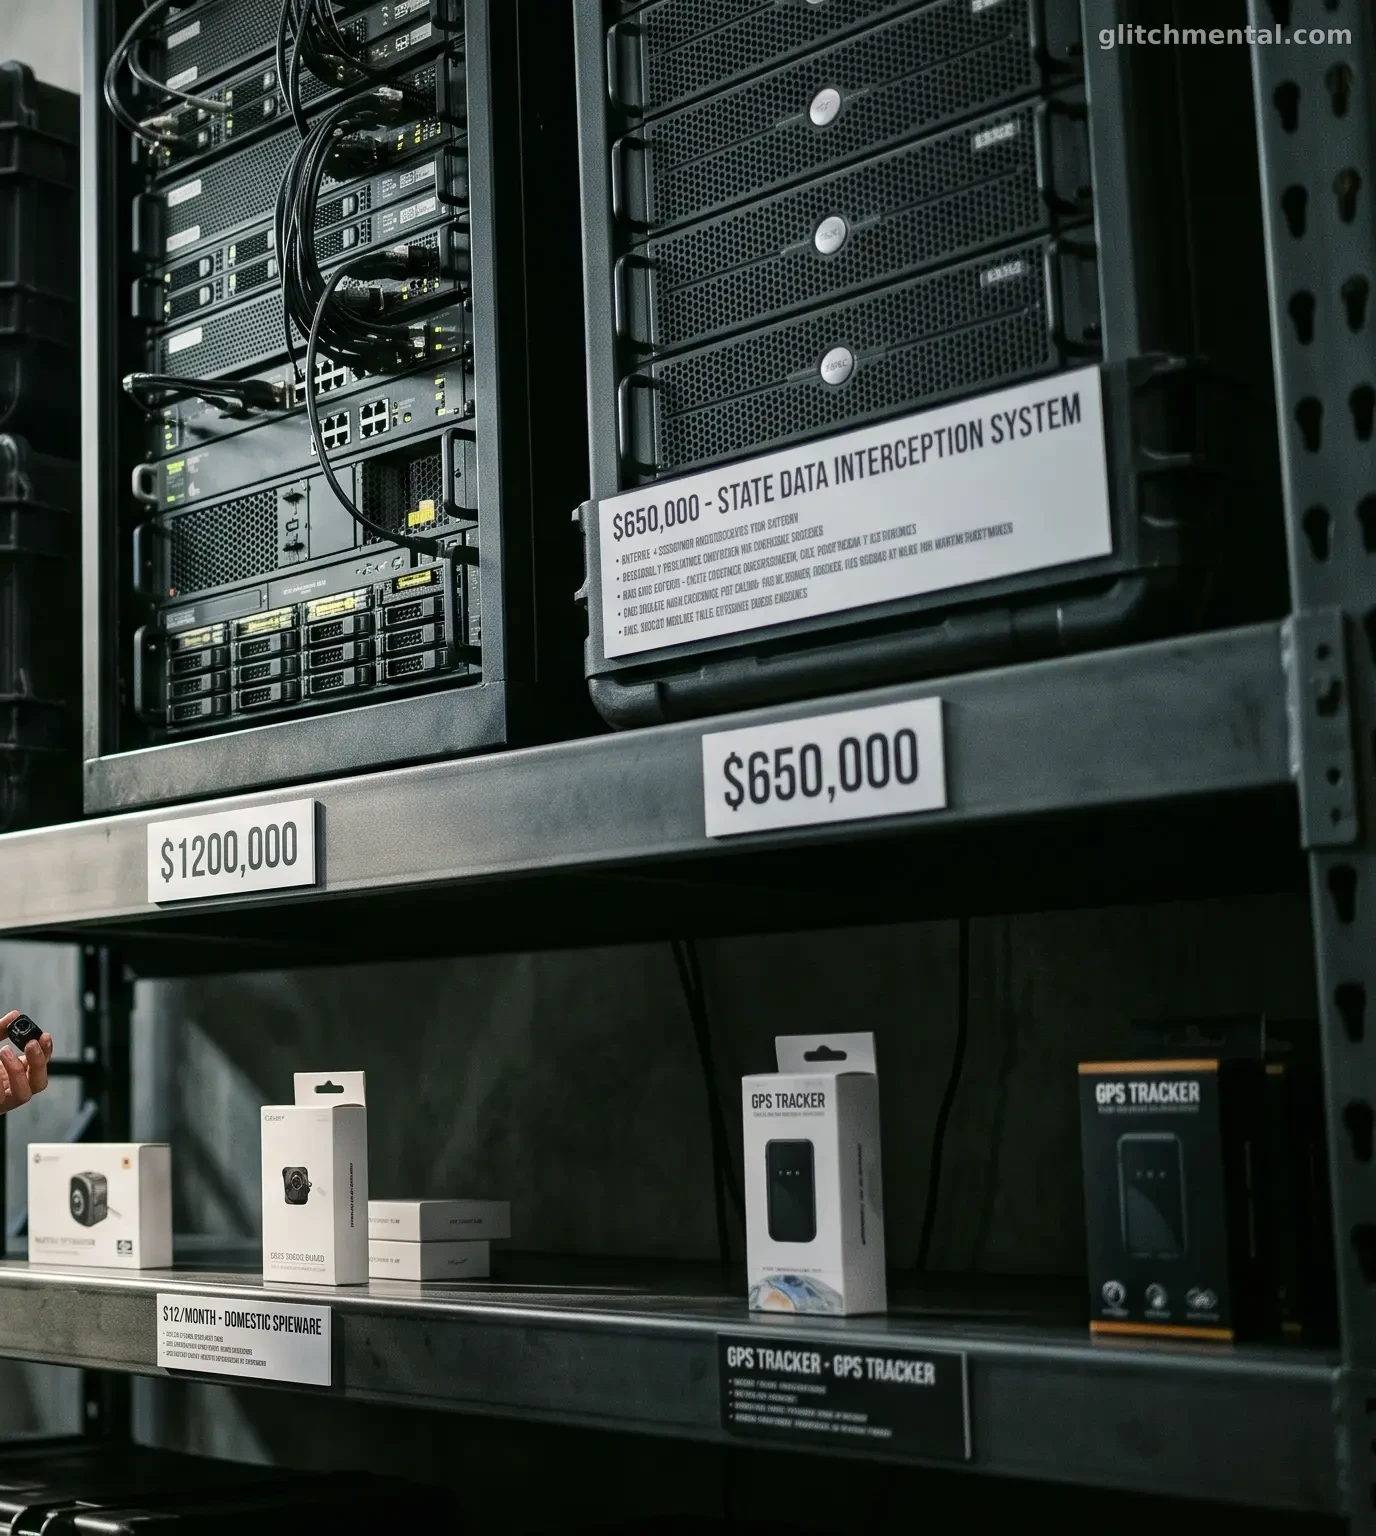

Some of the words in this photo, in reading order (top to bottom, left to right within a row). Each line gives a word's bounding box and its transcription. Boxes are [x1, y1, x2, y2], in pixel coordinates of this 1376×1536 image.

[613, 494, 700, 542] $650,000
[718, 474, 774, 514] STATE
[780, 461, 828, 499] DATA
[834, 418, 984, 486] INTERCEPTION
[990, 392, 1082, 445] SYSTEM
[724, 728, 918, 811] $650,000
[161, 821, 298, 883] $1200,000
[751, 1093, 773, 1109] GPS
[775, 1092, 826, 1109] TRACKER
[1096, 1082, 1126, 1104] GPS
[1128, 1082, 1200, 1103] TRACKER
[163, 1305, 217, 1326] $12/MONTH
[224, 1310, 271, 1331] DOMESTIC
[272, 1314, 322, 1336] SPIEWARE
[727, 1346, 755, 1369] GPS
[756, 1348, 822, 1375] TRACKER
[833, 1354, 864, 1379] GPS
[865, 1356, 937, 1386] TRACKER
